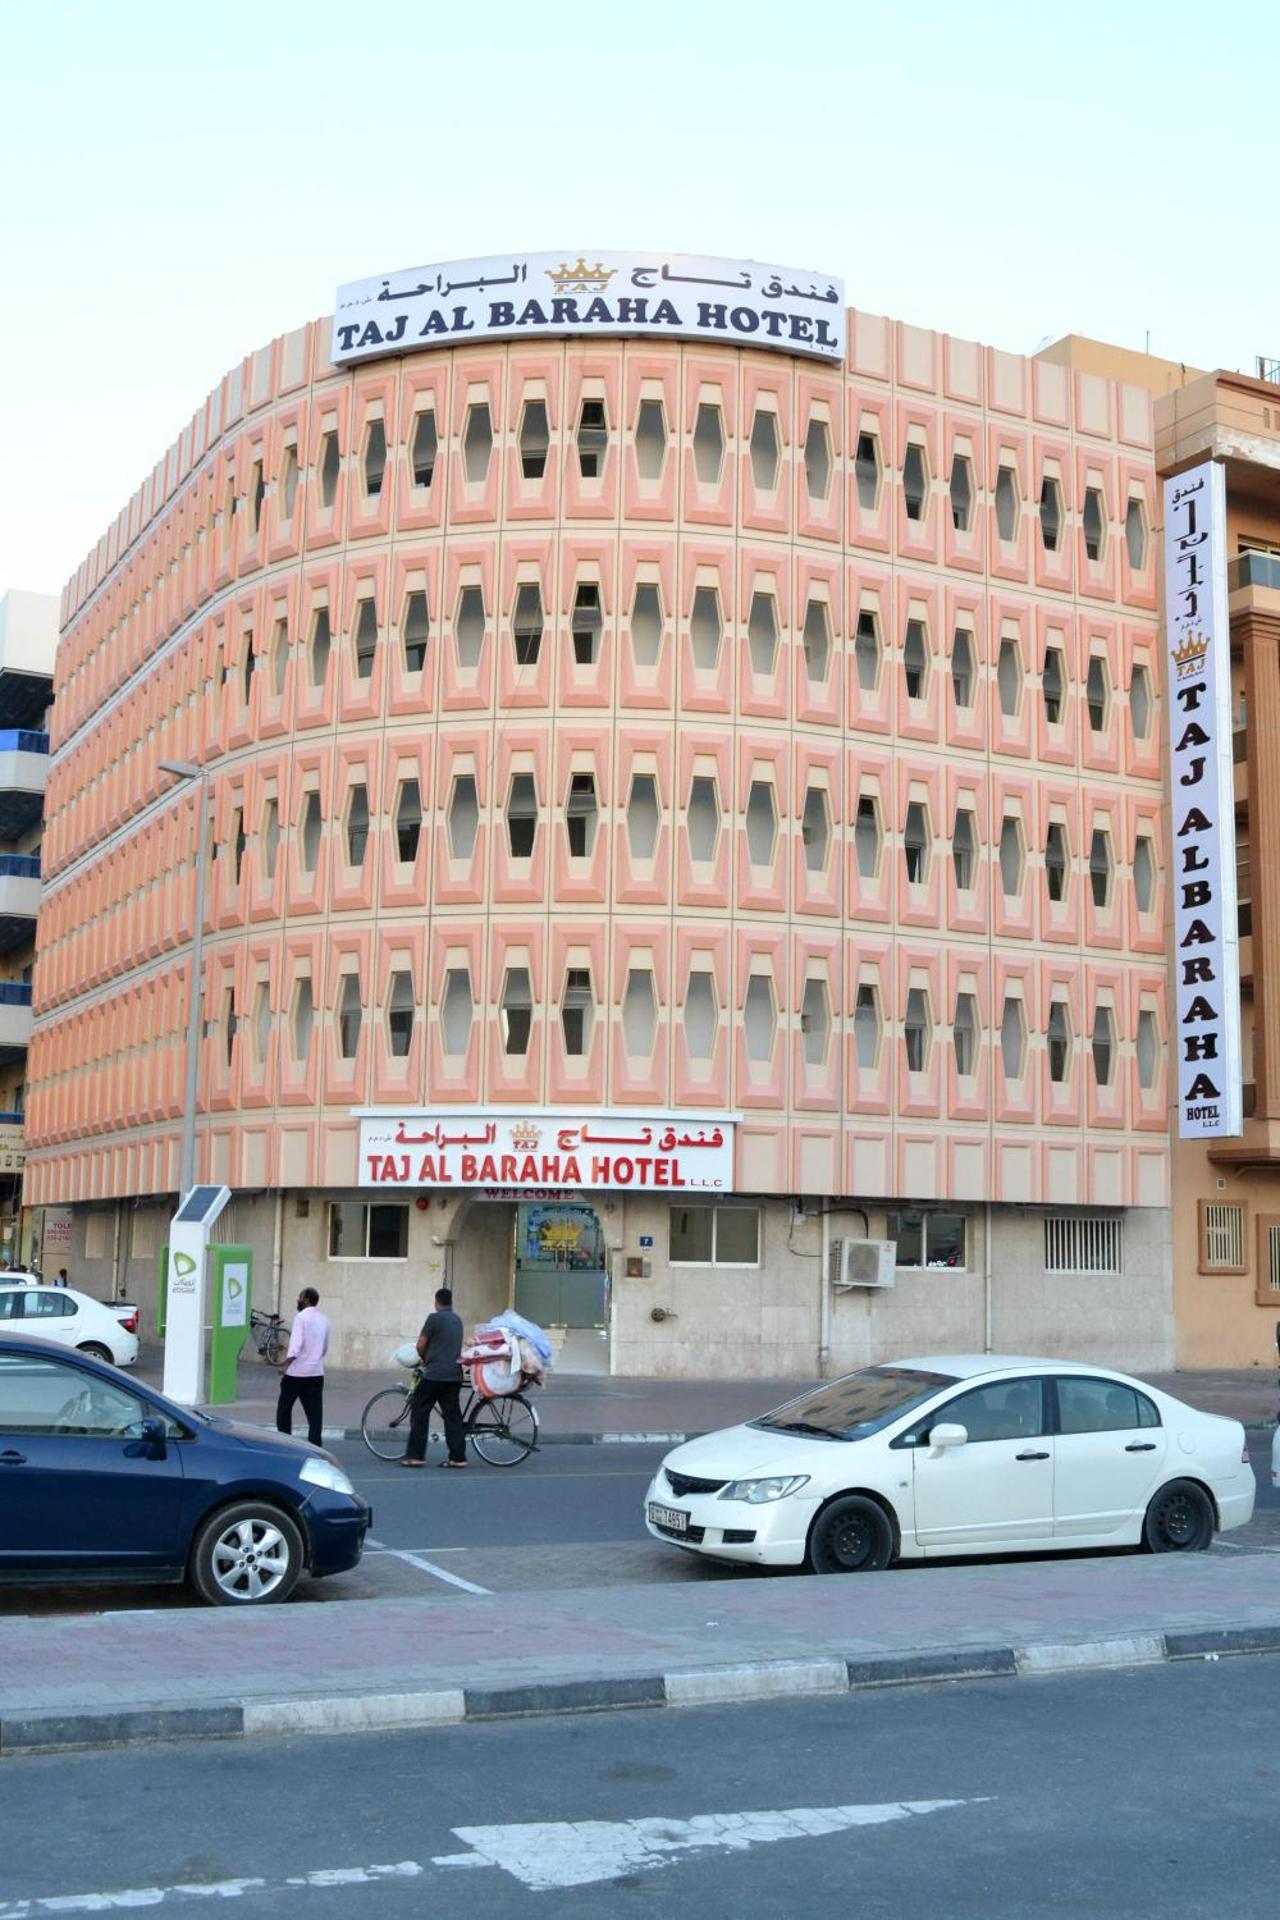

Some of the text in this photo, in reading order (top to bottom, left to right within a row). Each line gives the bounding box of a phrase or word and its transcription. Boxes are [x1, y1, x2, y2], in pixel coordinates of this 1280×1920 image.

[377, 263, 527, 302] البراحة
[631, 264, 752, 289] تاج
[761, 275, 839, 304] فندق
[337, 297, 839, 351] TAJ AL BARAHA HOTEL
[1175, 682, 1210, 786] TAJ
[1186, 1105, 1220, 1120] HOTEL
[395, 1122, 496, 1150] البراحة
[513, 1140, 539, 1150] TAJ
[557, 1124, 652, 1151] تاج
[658, 1127, 724, 1152] فندق
[367, 1154, 410, 1182] TAJ
[418, 1156, 452, 1182] AL
[460, 1155, 582, 1184] BARAHA
[591, 1156, 686, 1186] HOTEL
[484, 1188, 575, 1200] WELCOME
